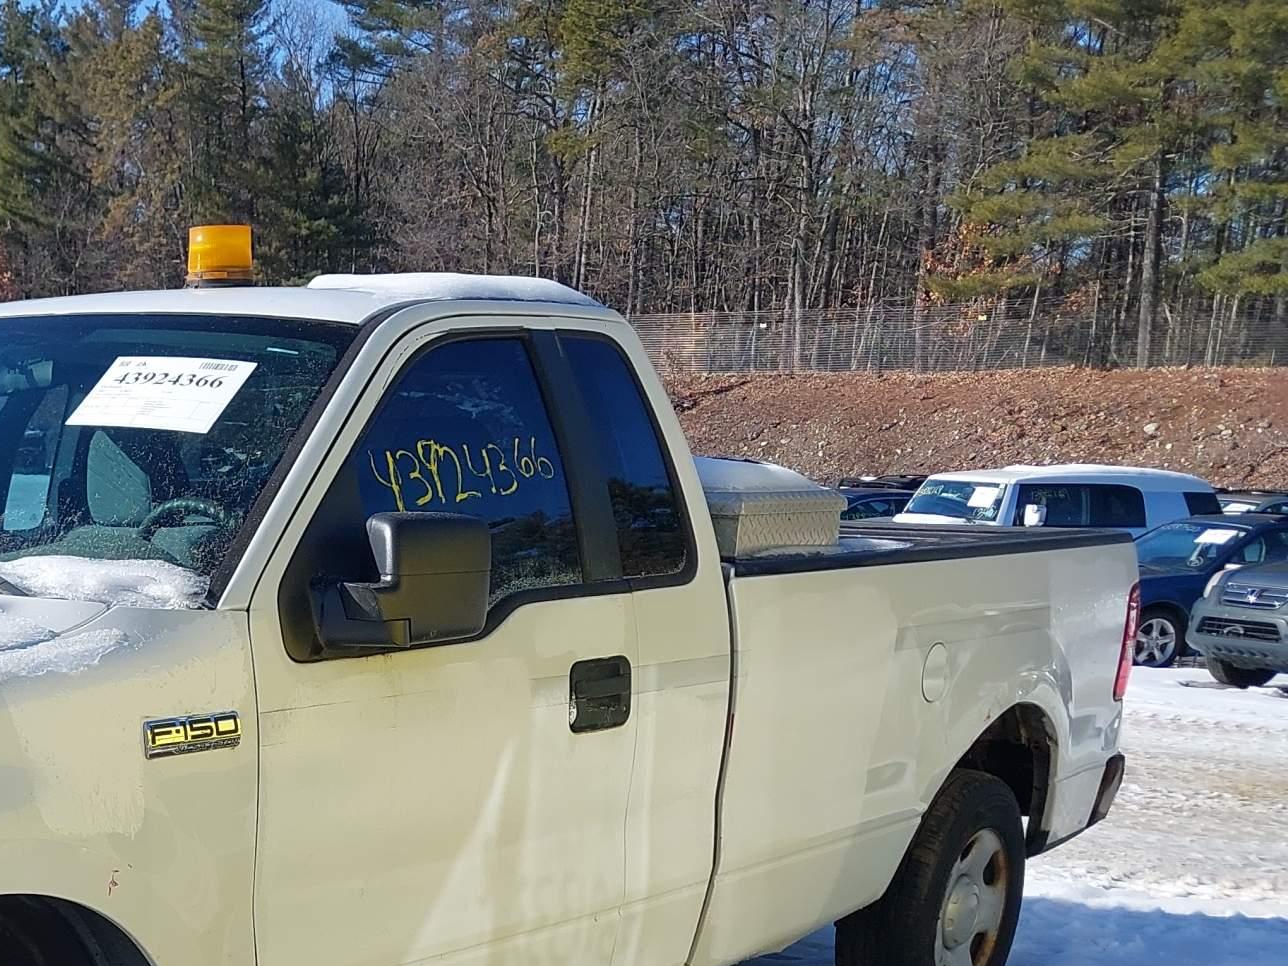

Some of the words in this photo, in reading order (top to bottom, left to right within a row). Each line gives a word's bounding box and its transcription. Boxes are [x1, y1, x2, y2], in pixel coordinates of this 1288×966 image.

[113, 371, 228, 389] 43924366
[367, 436, 554, 512] 43924366
[149, 714, 239, 745] F-150
